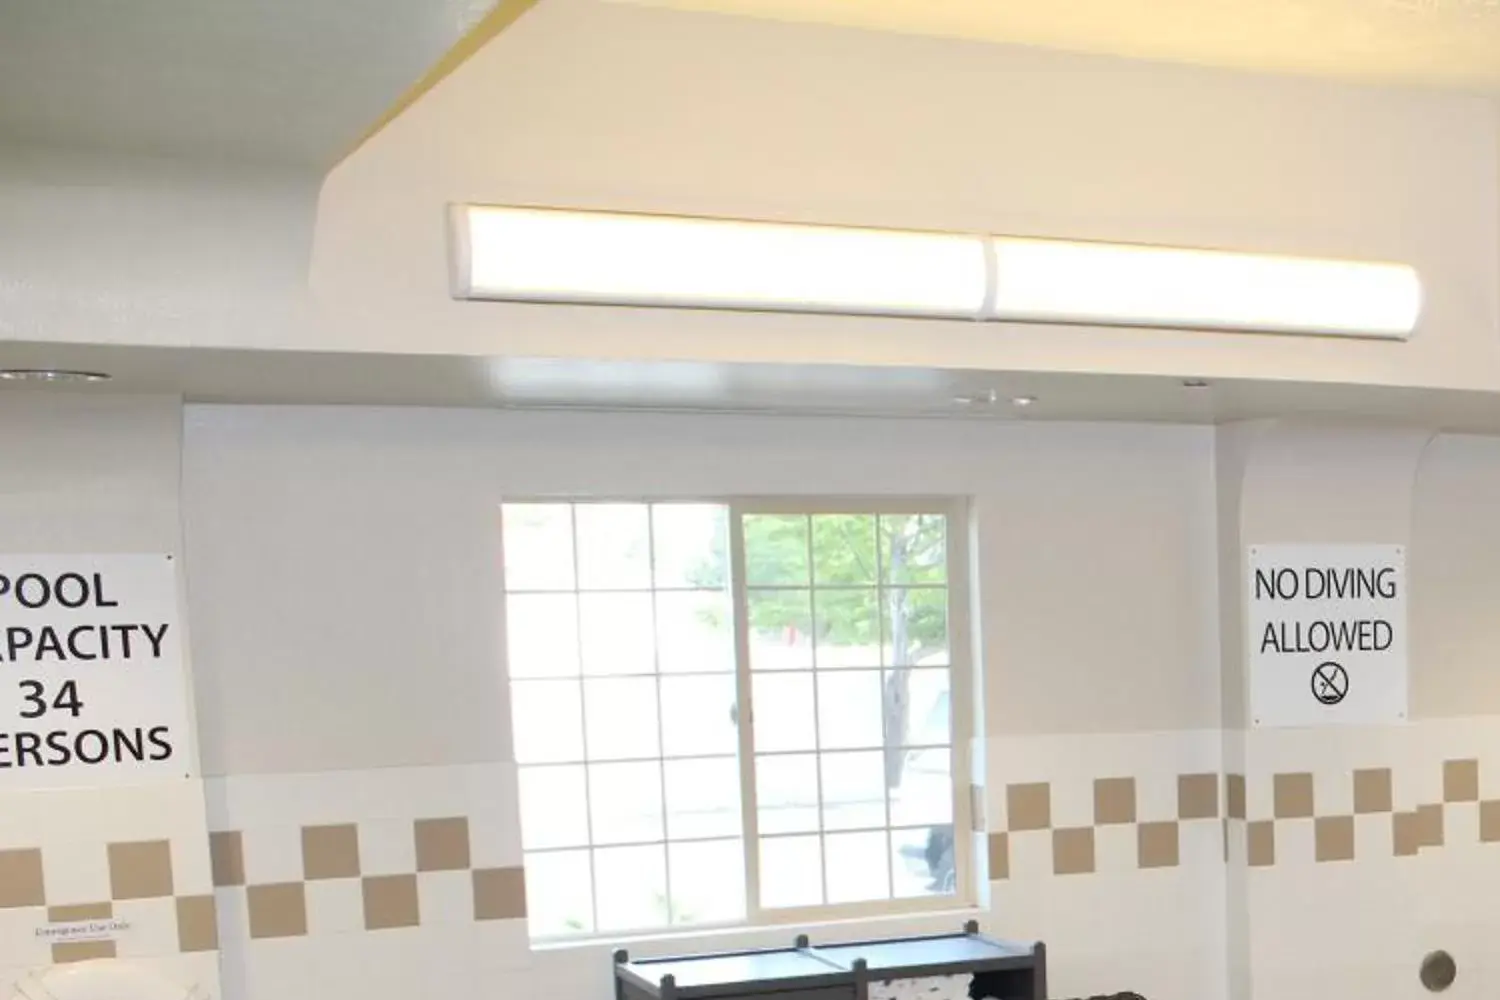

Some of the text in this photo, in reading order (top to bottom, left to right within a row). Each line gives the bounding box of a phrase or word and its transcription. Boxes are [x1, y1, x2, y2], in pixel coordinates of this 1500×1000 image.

[1256, 567, 1397, 600] NO DIVING
[0, 623, 169, 662] PACITY
[1260, 619, 1394, 654] ALLOWED
[19, 679, 84, 719] 34
